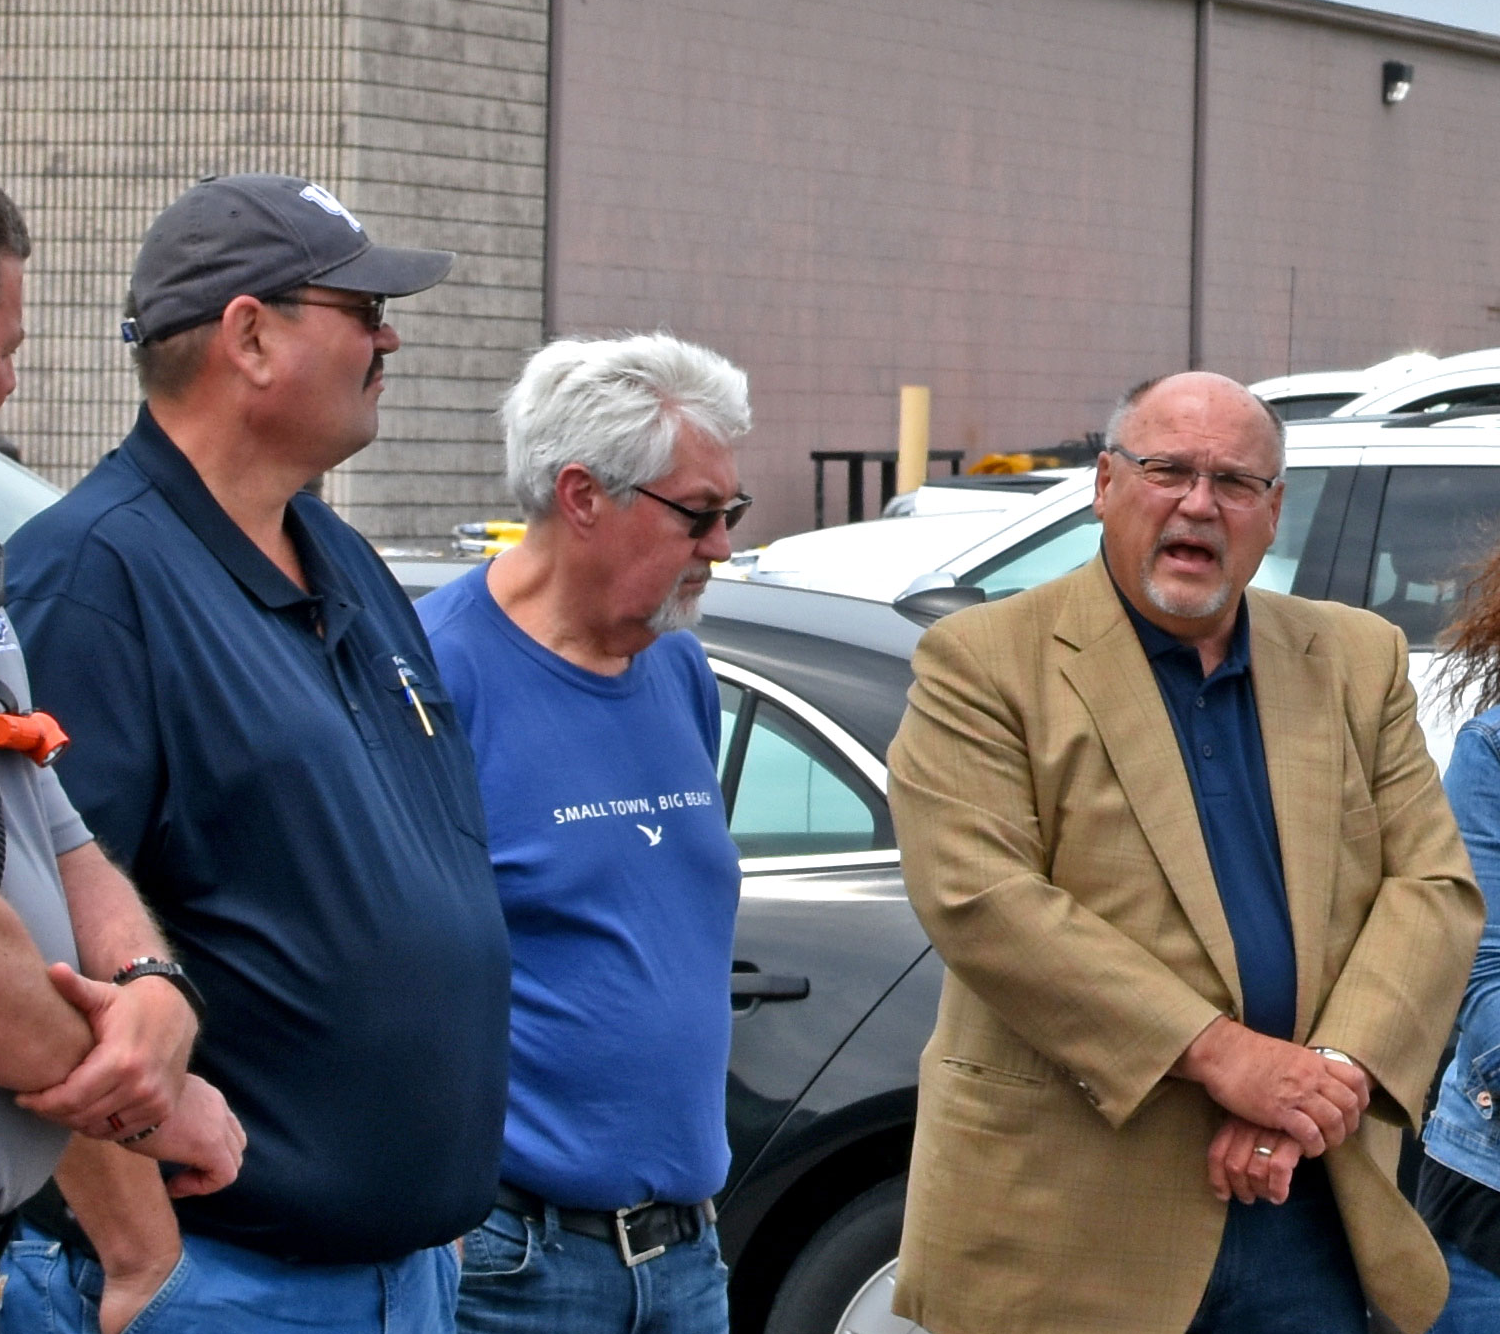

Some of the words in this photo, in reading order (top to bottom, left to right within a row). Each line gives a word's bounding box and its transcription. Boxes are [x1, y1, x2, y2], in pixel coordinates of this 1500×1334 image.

[553, 803, 608, 825] SMALL
[609, 798, 655, 816] TOWN,
[658, 794, 683, 810] BIG
